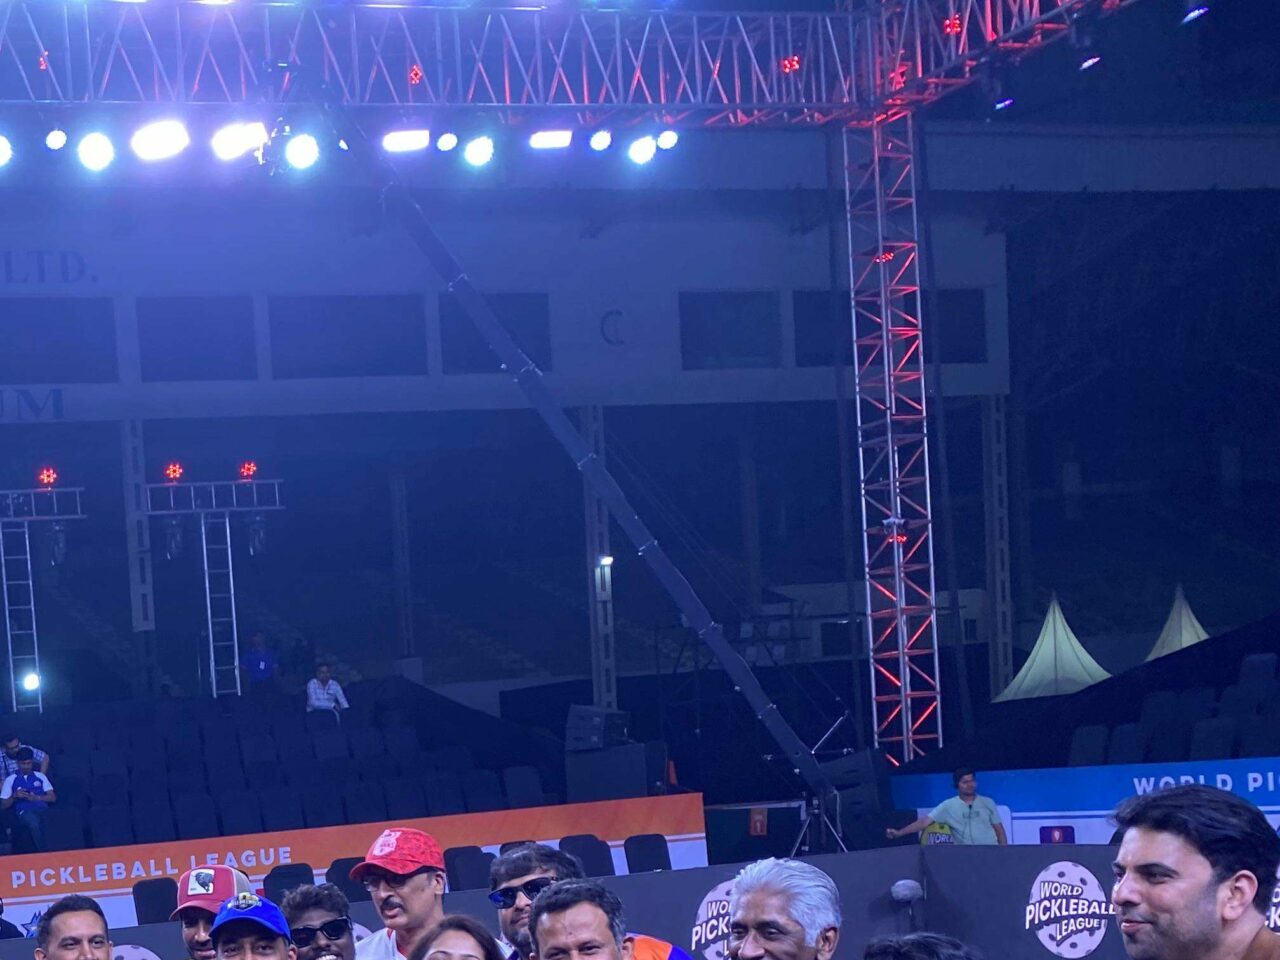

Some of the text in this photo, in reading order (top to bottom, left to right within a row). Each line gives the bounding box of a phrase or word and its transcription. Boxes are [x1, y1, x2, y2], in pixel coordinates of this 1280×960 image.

[4, 250, 99, 285] LTD.
[12, 857, 179, 887] PICKLEBALL
[191, 846, 293, 870] LEAGUE
[1040, 882, 1082, 899] WORLD
[1025, 898, 1116, 930] PICKLEBALL
[1056, 917, 1101, 941] LEAGUE
